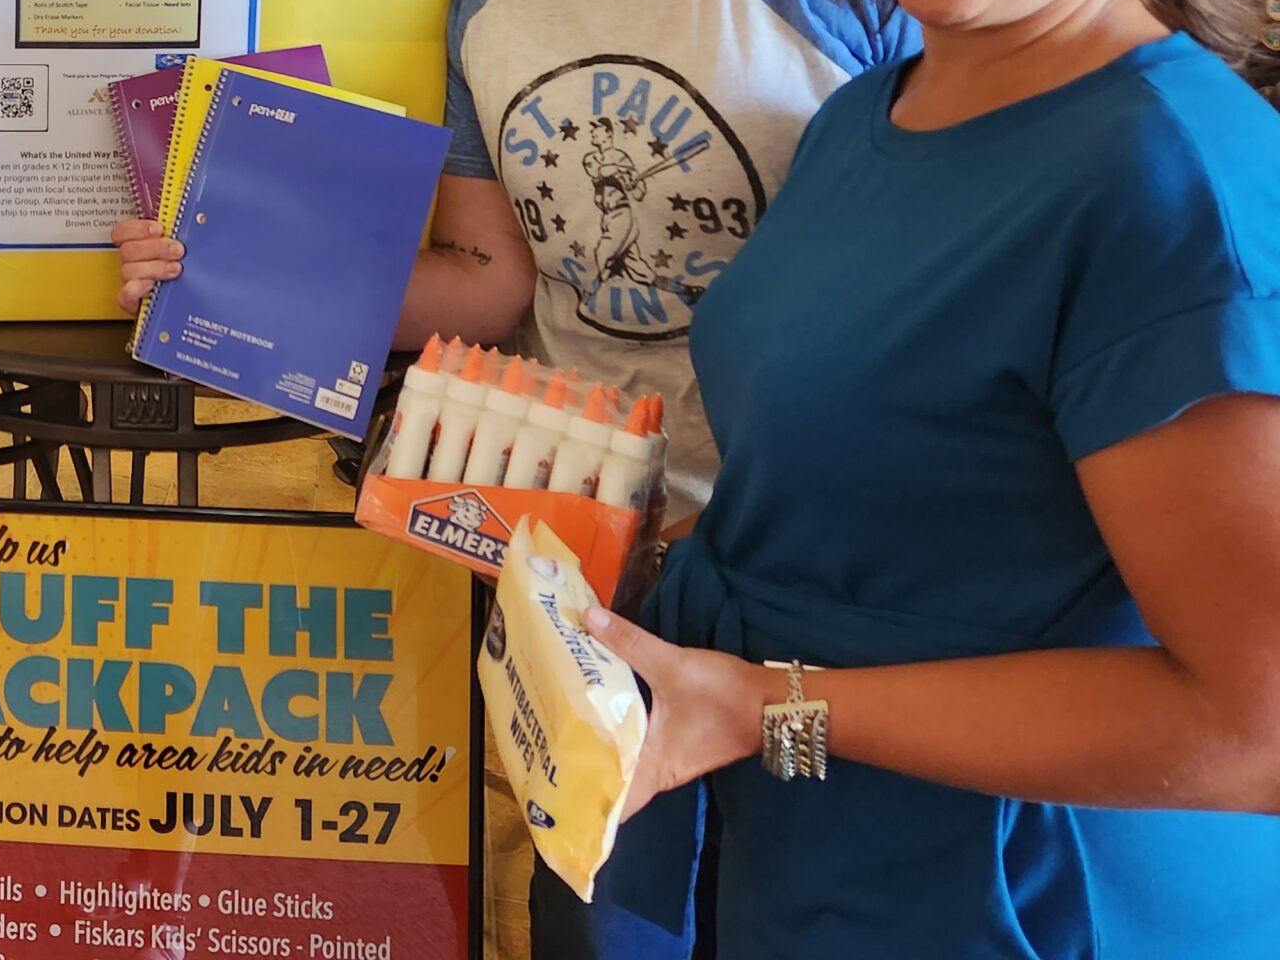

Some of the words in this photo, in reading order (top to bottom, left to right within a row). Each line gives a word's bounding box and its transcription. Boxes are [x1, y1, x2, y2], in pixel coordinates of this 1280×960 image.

[35, 25, 67, 35] Thank
[71, 27, 89, 38] you
[92, 24, 105, 37] for
[109, 27, 132, 38] your
[135, 25, 182, 35] donation!
[249, 103, 297, 124] pen+GEAR
[592, 71, 712, 173] PAUL
[20, 151, 47, 159] What's
[50, 151, 62, 159] the
[65, 151, 91, 159] United
[93, 151, 111, 160] Way
[22, 163, 50, 172] grades
[82, 162, 108, 170] Brown
[4, 175, 39, 183] program
[58, 174, 101, 183] participate
[14, 187, 24, 195] up
[71, 209, 117, 217] opportunity
[77, 198, 99, 206] Bank,
[692, 196, 751, 240] 93
[229, 328, 274, 351] NOTEBOOK
[26, 539, 67, 567] us
[200, 581, 393, 662] THE
[505, 655, 558, 788] ANTIBACTERIAL
[32, 728, 109, 778] help
[116, 743, 207, 772] area
[207, 736, 287, 776] kids
[293, 745, 339, 778] in
[337, 746, 449, 784] need!
[510, 711, 535, 773] WIPES
[58, 805, 141, 832] DATES
[148, 791, 274, 839] JULY
[294, 798, 402, 846] 1-27
[60, 880, 192, 915] Highlighters
[218, 890, 267, 917] Glue
[273, 893, 334, 920] Sticks
[75, 920, 145, 949] Fiskars
[151, 924, 201, 952] Kids'
[208, 928, 291, 958] Scissors
[310, 934, 391, 960] Pointed
